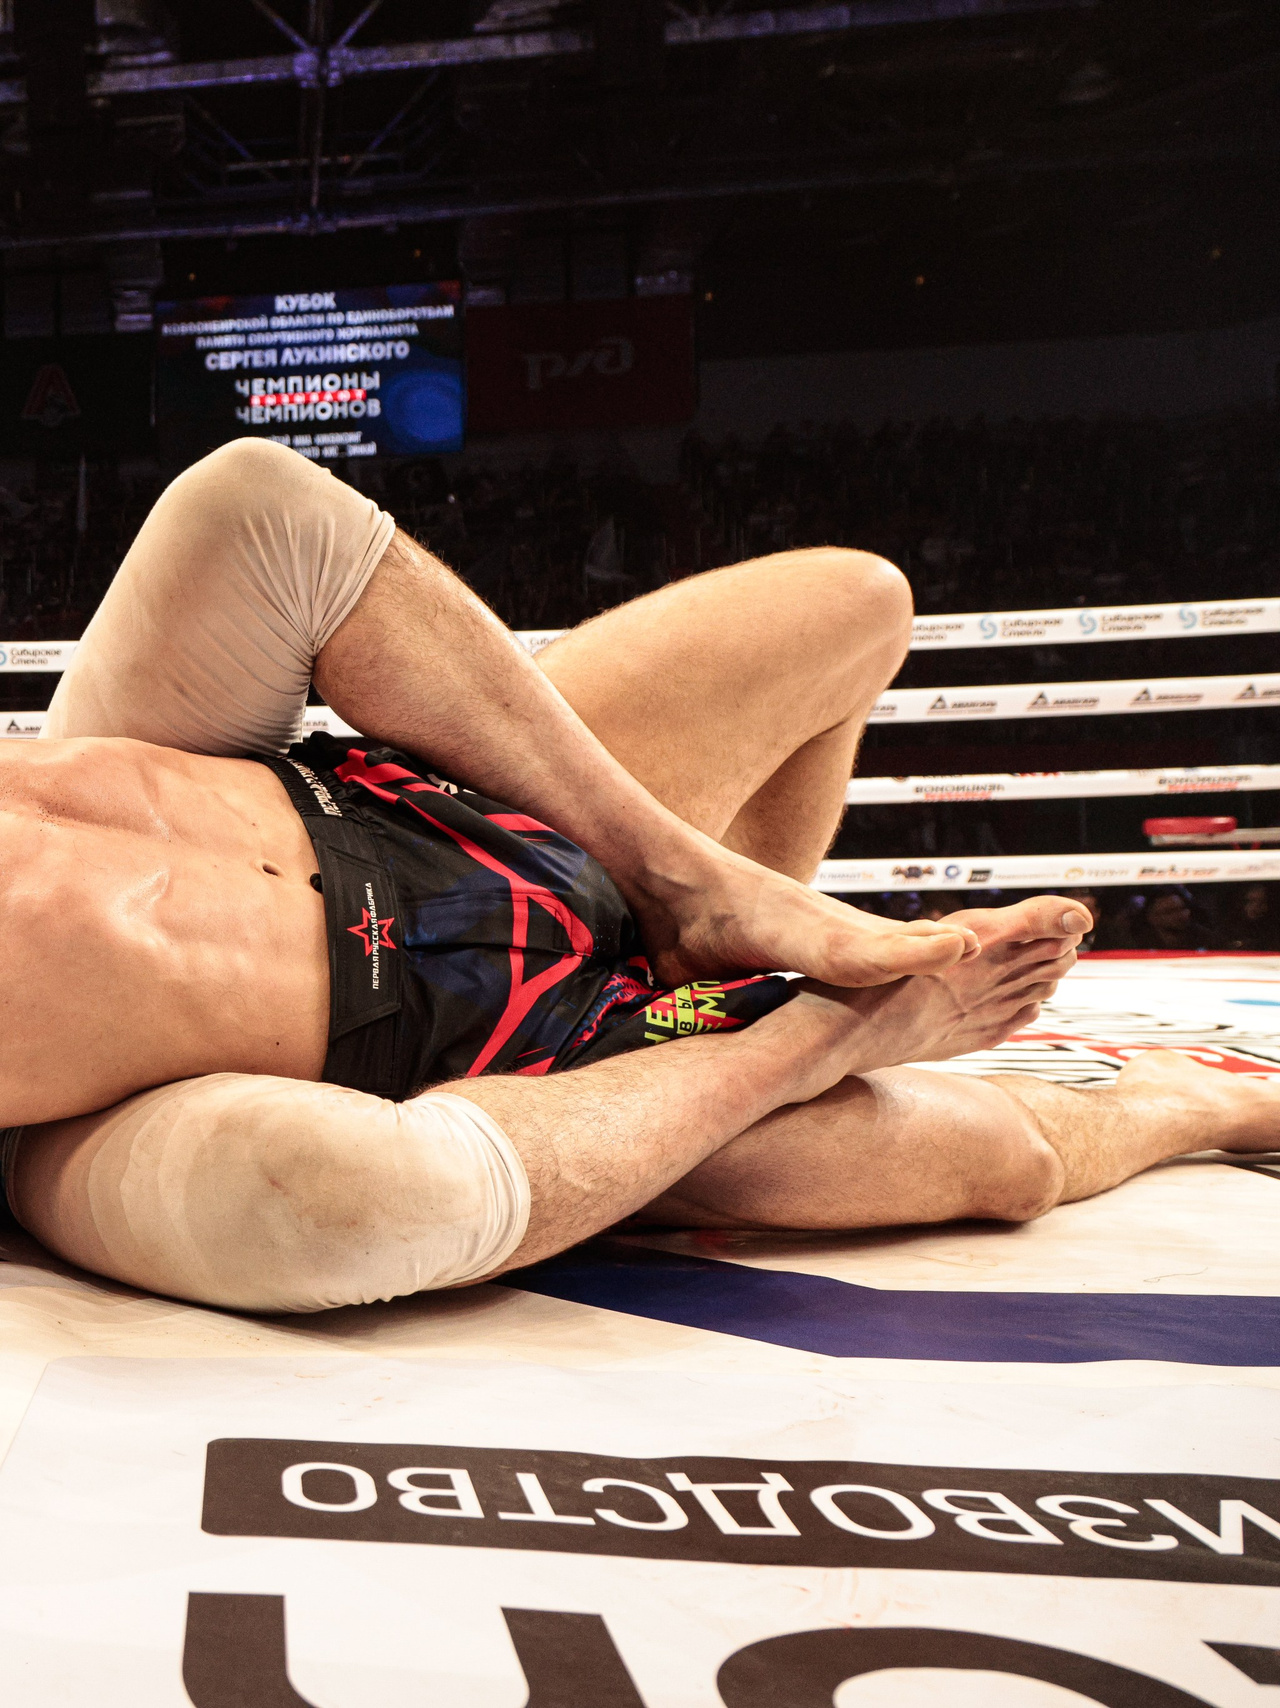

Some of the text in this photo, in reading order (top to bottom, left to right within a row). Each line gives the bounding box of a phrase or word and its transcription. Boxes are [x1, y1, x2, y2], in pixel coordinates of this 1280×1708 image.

[275, 292, 336, 311] КУБОК
[205, 340, 410, 371] СЕРГЕЯ ЛУКИНСКОГО
[235, 371, 380, 397] ЧЕМПИОНЫ
[235, 398, 381, 425] ЧЕМПИОНОВ
[365, 882, 377, 918] ФАБРИКА
[371, 918, 379, 955] РУССКАЯ
